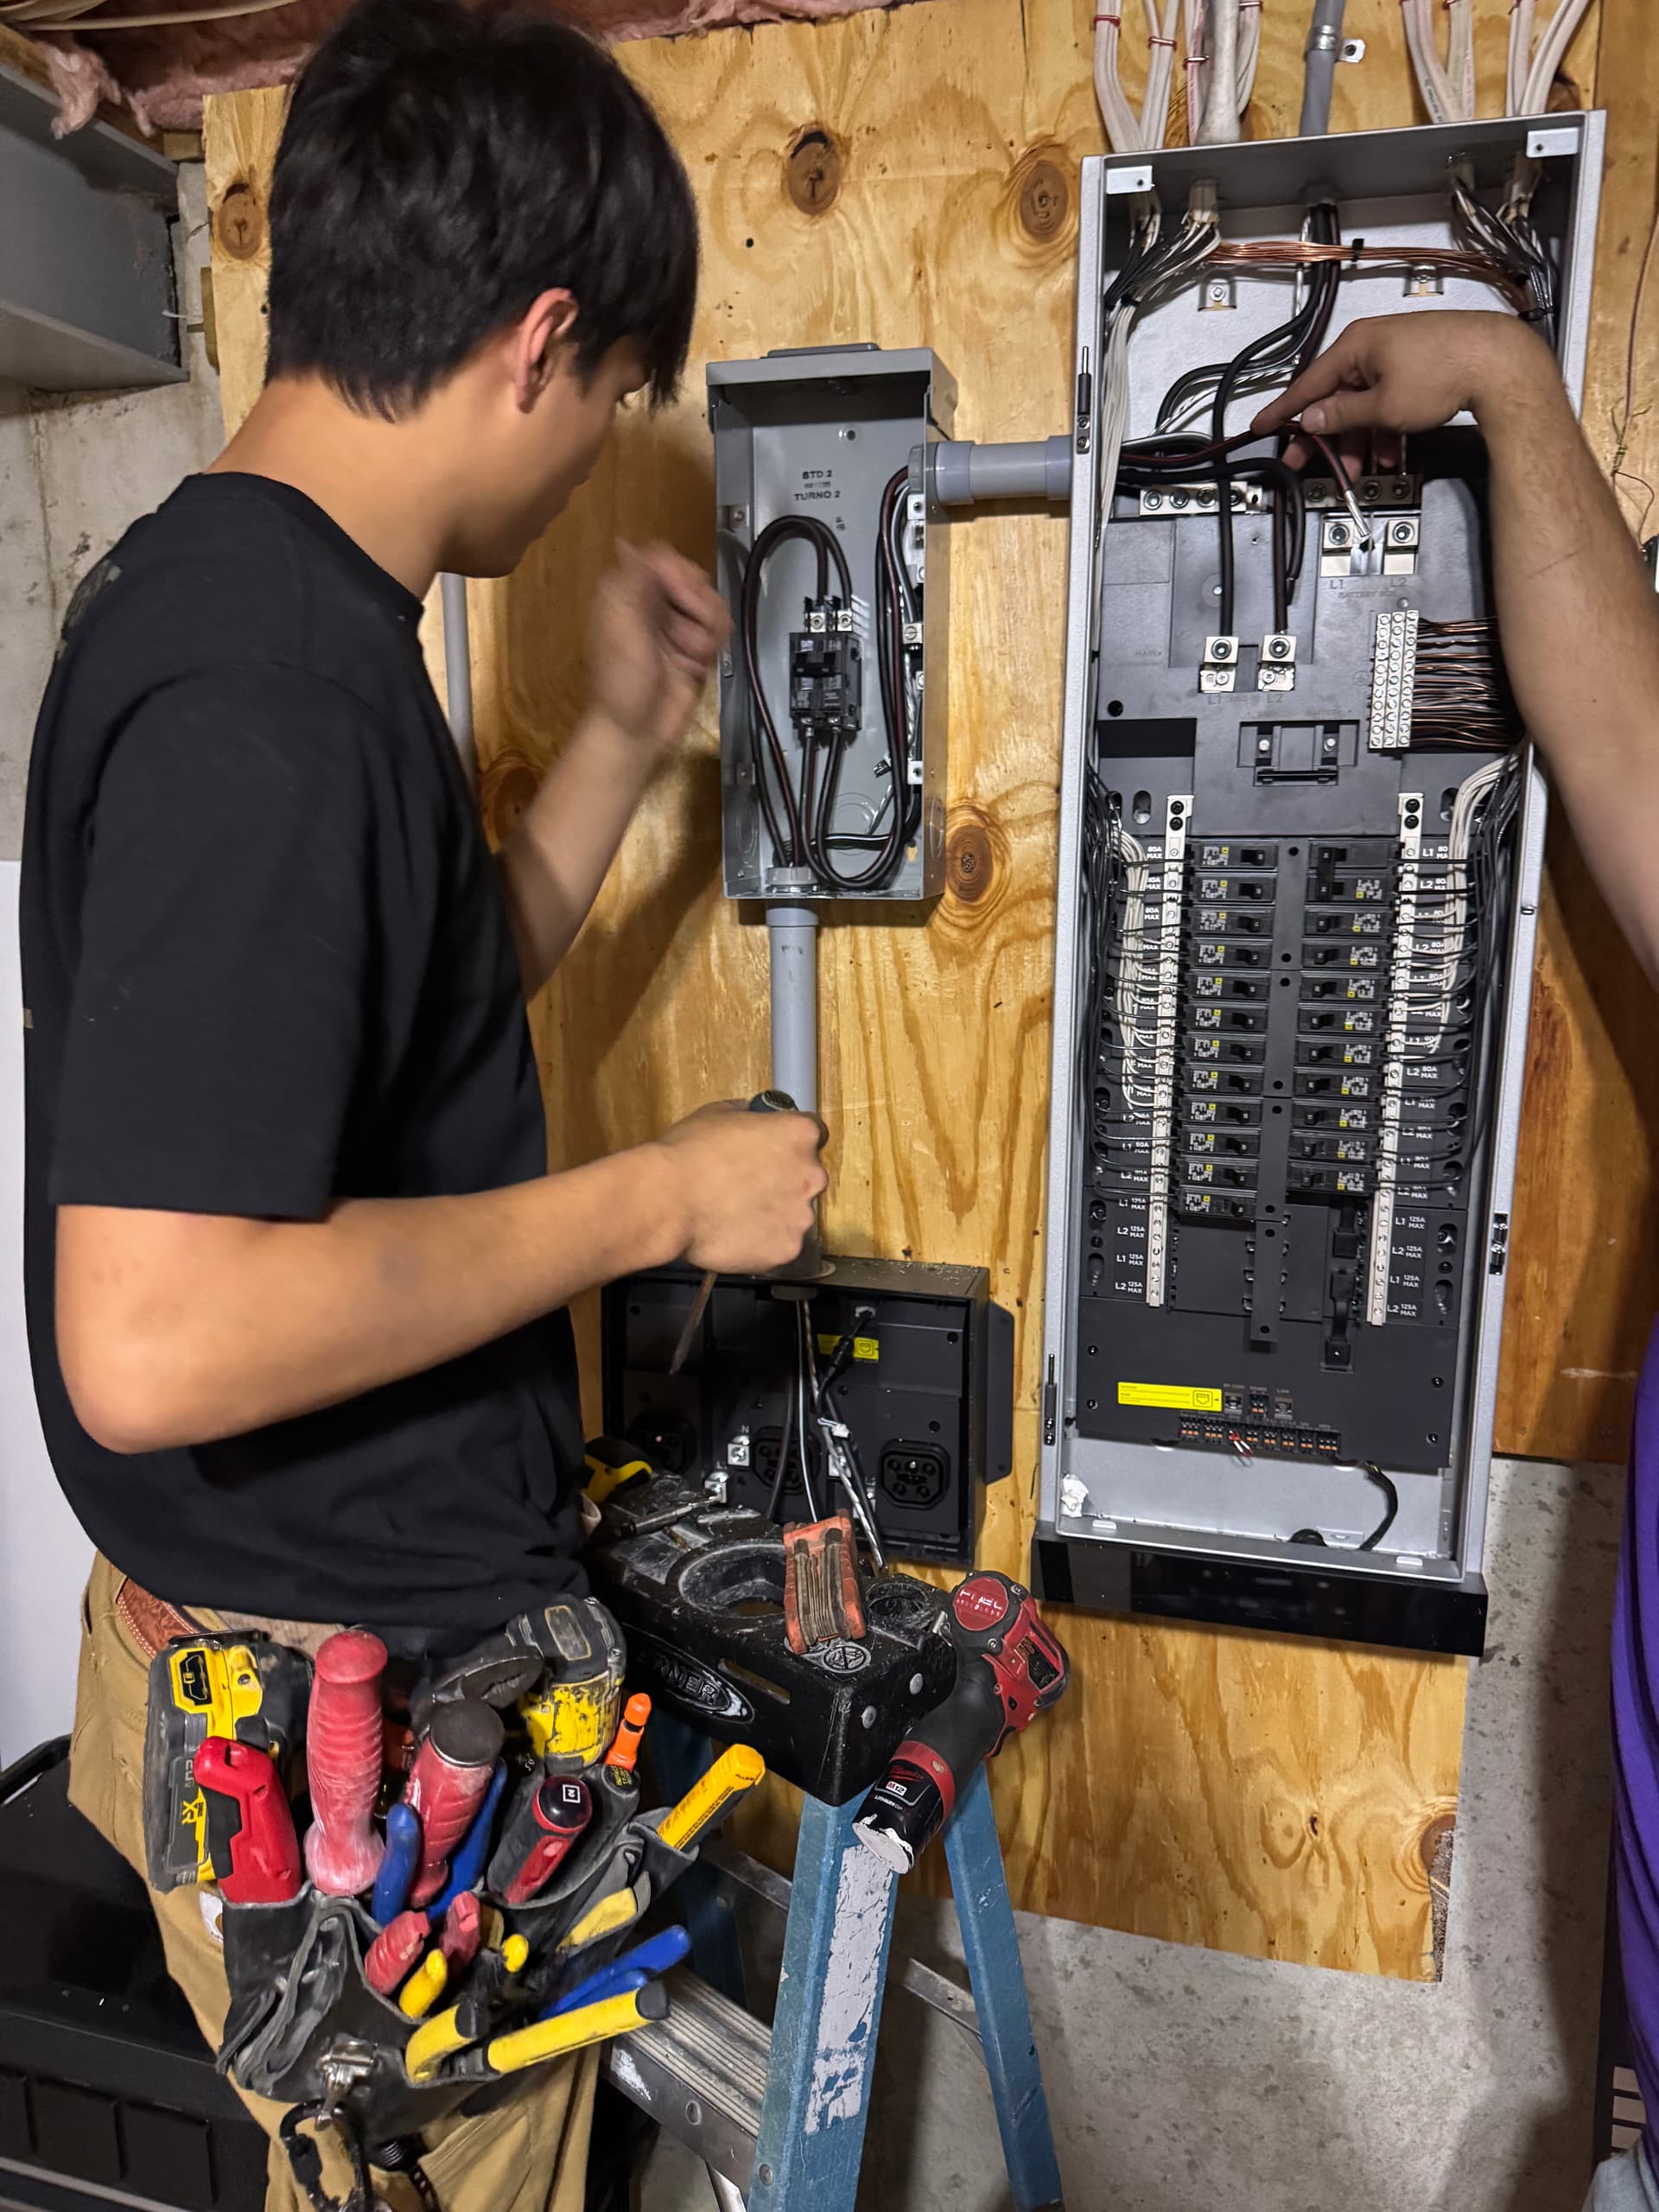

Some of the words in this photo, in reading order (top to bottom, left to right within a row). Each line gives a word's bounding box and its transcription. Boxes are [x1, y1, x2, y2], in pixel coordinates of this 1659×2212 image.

[1422, 848, 1433, 856] L1
[1420, 880, 1433, 889] L2
[1407, 1067, 1420, 1076] L2
[1395, 1217, 1406, 1225] L1
[1391, 1246, 1404, 1255] L2
[1116, 1254, 1126, 1262] L1
[1389, 1275, 1400, 1284] L1
[1115, 1281, 1127, 1290] L2
[1387, 1304, 1399, 1313] L2
[887, 1782, 906, 1795] M12
[181, 1801, 198, 1825] XR
